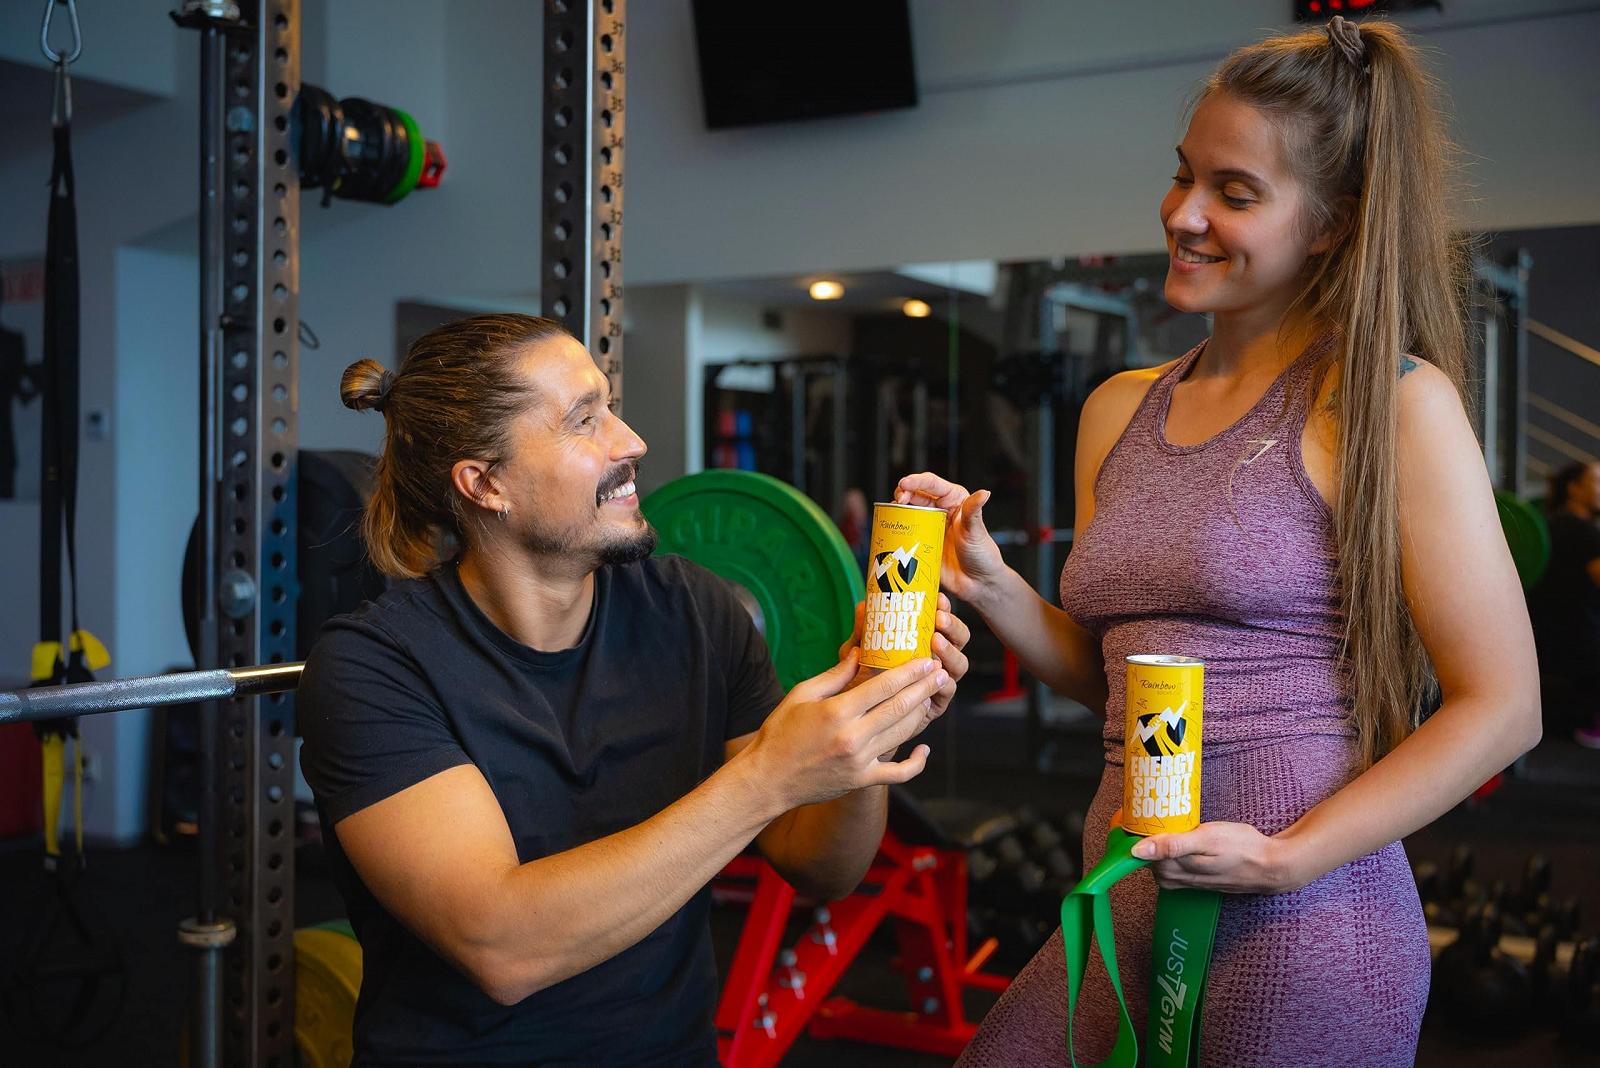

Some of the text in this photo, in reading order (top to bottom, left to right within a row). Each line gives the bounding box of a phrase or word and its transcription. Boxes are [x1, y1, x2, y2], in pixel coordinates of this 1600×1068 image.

[612, 21, 625, 36] 37
[612, 59, 625, 74] 36
[611, 96, 625, 112] 35
[610, 171, 623, 187] 33
[610, 209, 623, 225] 32
[880, 520, 910, 531] Rainbow
[867, 592, 925, 612] ENERGY
[866, 611, 920, 631] SPORT
[864, 630, 918, 651] SOCKS
[1140, 679, 1177, 690] Rainbow
[1131, 751, 1196, 777] ENERGY
[1133, 772, 1192, 799] SPORT
[1132, 795, 1191, 818] SOCKS
